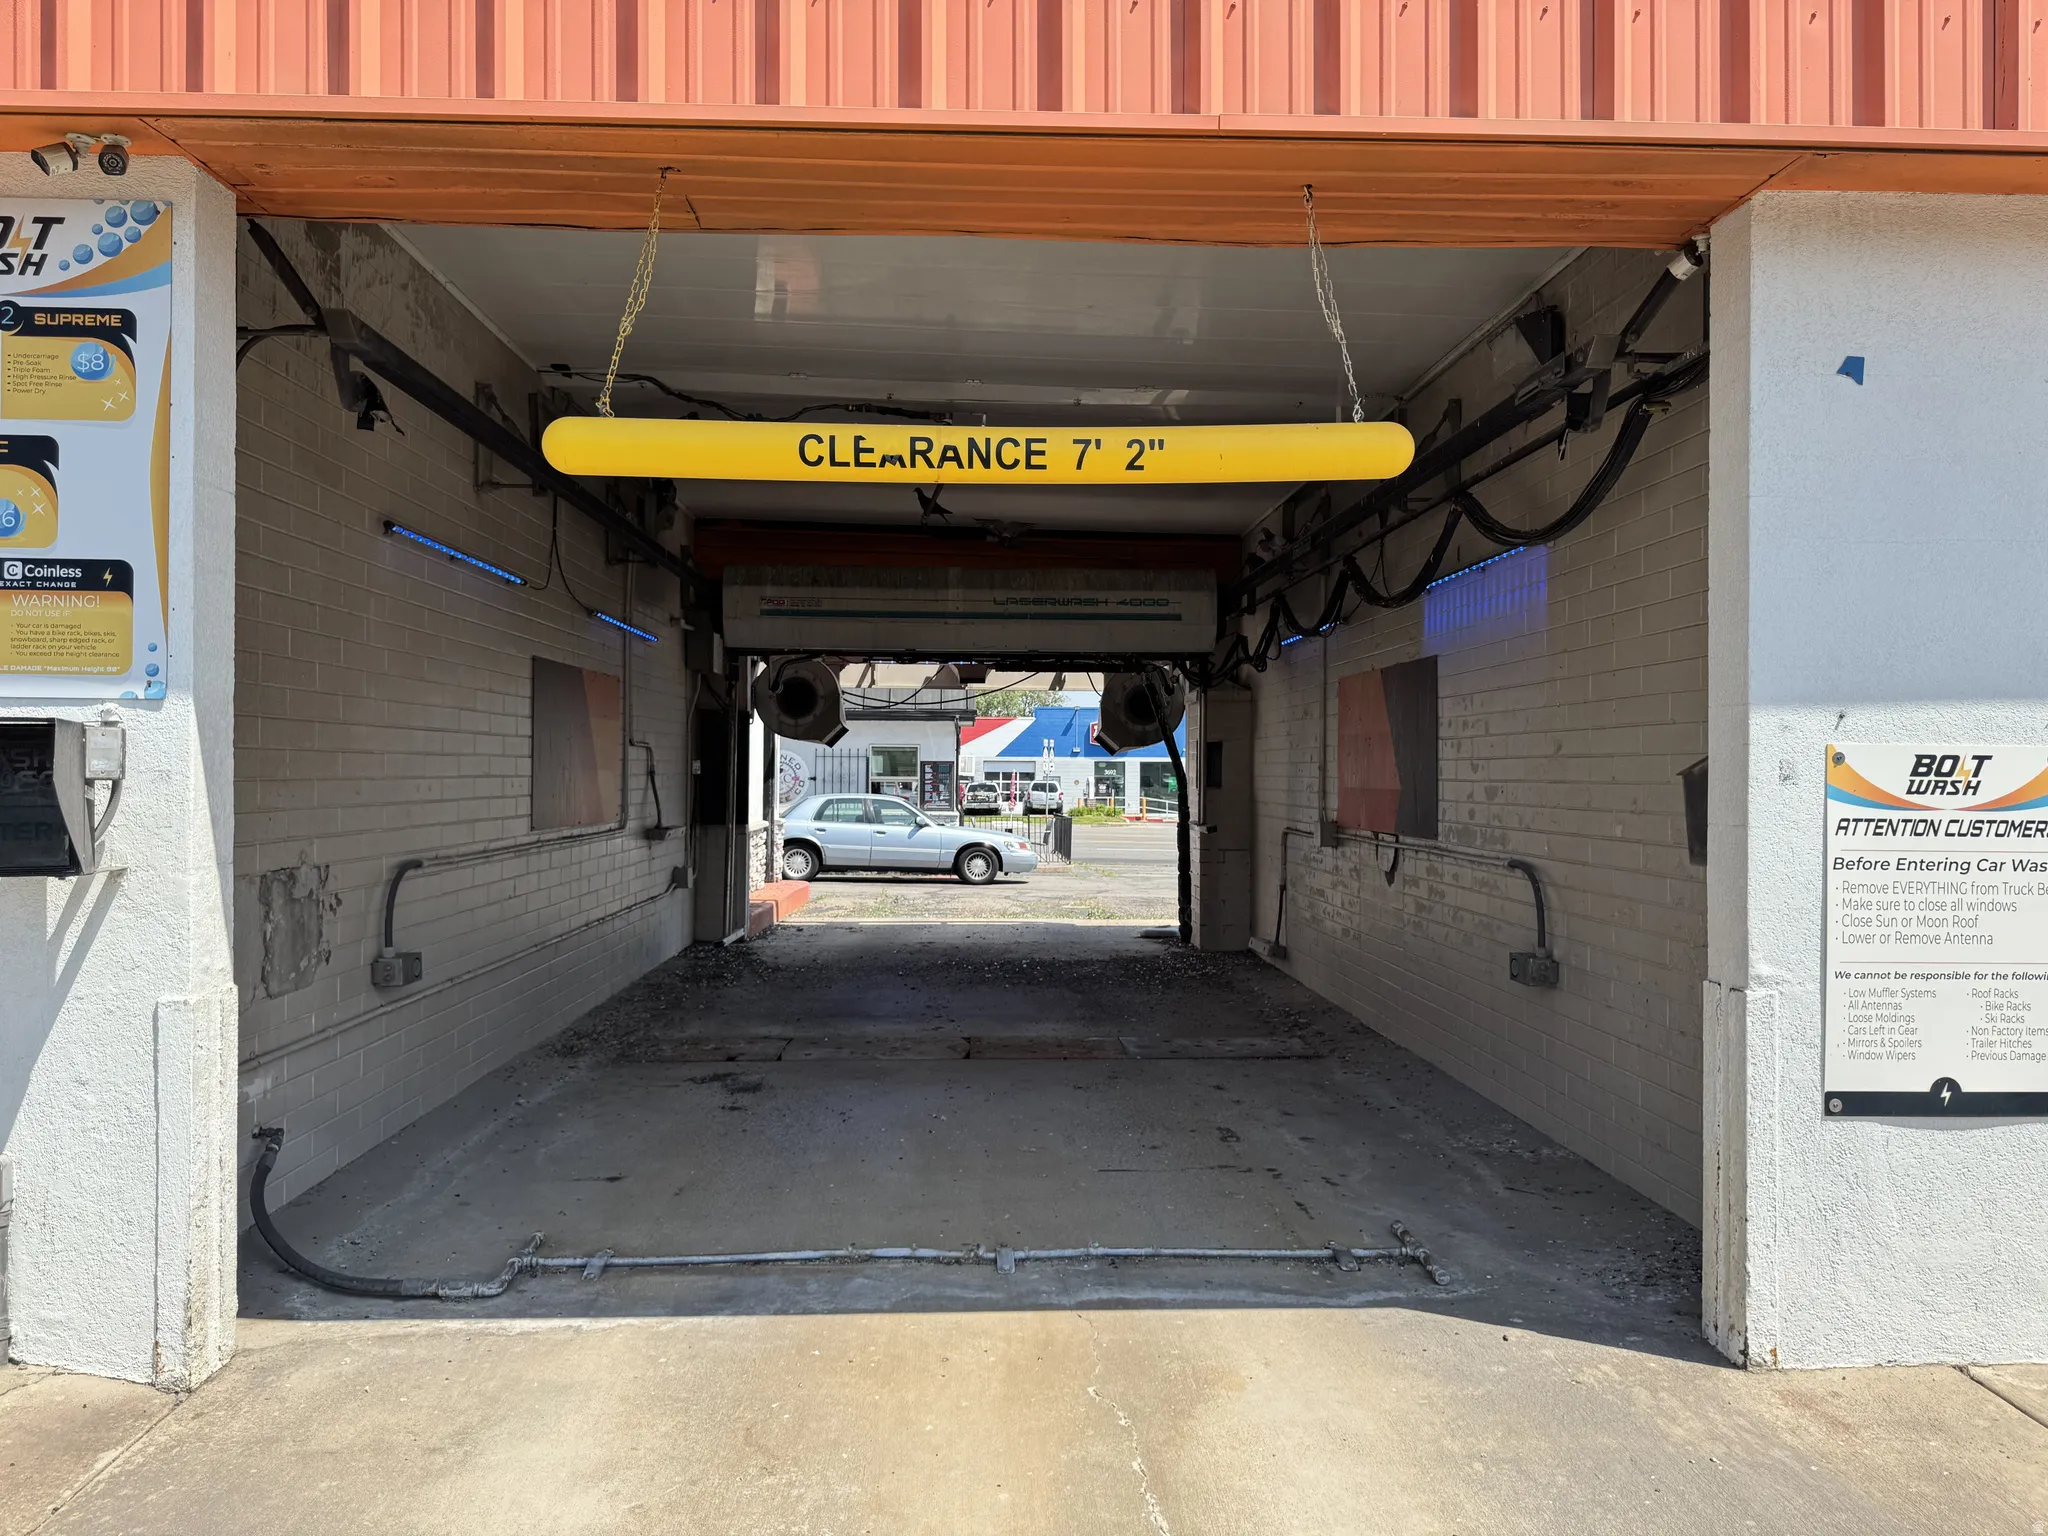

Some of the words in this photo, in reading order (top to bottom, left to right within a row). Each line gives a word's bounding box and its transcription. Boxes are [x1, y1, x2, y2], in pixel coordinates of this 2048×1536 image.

[1, 307, 14, 325] 2
[34, 313, 122, 327] SUPREME
[77, 351, 104, 373] $8
[1072, 438, 1101, 471] 7'
[1125, 438, 1165, 471] 2"
[24, 564, 82, 578] Coinless
[12, 594, 100, 608] WARNING!
[993, 597, 1108, 606] LASERWASH
[1116, 598, 1170, 606] 4000
[1906, 779, 1981, 796] WASH
[1835, 818, 1942, 837] ATTENTION
[1944, 819, 2048, 838] CUSTOMER
[1833, 856, 1890, 871] Before
[1896, 857, 1971, 875] Entering
[1976, 858, 2006, 873] Car
[1842, 880, 1889, 895] Remove
[1892, 882, 1968, 896] EVERYTHING
[1970, 881, 1999, 896] from
[2002, 882, 2034, 896] Truck
[1842, 897, 1873, 912] Make
[1876, 901, 1902, 912] sure
[1904, 898, 1916, 912] to
[1918, 898, 1948, 912] close
[1950, 898, 1963, 912] all
[1966, 898, 2018, 913] windows
[1842, 914, 1872, 928] Close
[1876, 914, 1898, 928] Sun
[1900, 918, 1914, 928] or
[1916, 914, 1950, 928] Moon
[1952, 914, 1980, 929] Roof
[1842, 931, 1876, 944] Lower
[1879, 934, 1892, 944] or
[1894, 931, 1942, 945] Remove
[1944, 932, 1994, 946] Antenna
[1834, 970, 1852, 980] We
[1854, 971, 1892, 980] cannot
[1894, 970, 1908, 980] be
[1910, 970, 1972, 982] responsible
[1973, 970, 1989, 981] for
[1990, 971, 2009, 981] the
[2011, 972, 2048, 982] followi
[1848, 988, 1866, 998] Low
[1868, 987, 1899, 998] Muffler
[1900, 988, 1937, 1001] Systems
[1972, 988, 1992, 999] Roof
[1994, 988, 2019, 999] Racks
[1848, 1000, 1860, 1011] All
[1861, 1000, 1903, 1011] Antennas
[1985, 1000, 2004, 1012] Bike
[2006, 1000, 2032, 1012] Racks
[1848, 1013, 1873, 1024] Loose
[1876, 1012, 1915, 1026] Moldings
[1984, 1012, 1998, 1024] Ski
[2000, 1013, 2025, 1024] Racks
[1848, 1025, 1866, 1036] Cars
[1868, 1025, 1885, 1036] Left
[1887, 1025, 1896, 1036] in
[1898, 1025, 1918, 1036] Gear
[1972, 1026, 1990, 1036] Non
[1991, 1026, 2024, 1038] Factory
[1848, 1038, 1878, 1048] Mirrors
[1880, 1038, 1886, 1048] &
[1888, 1037, 1922, 1050] Spoilers
[1971, 1038, 1998, 1048] Trailer
[2000, 1038, 2032, 1049] Hitches
[1848, 1050, 1883, 1060] Window
[1886, 1050, 1916, 1062] Wipers
[1971, 1050, 2008, 1061] Previous
[2009, 1050, 2047, 1063] Damage
